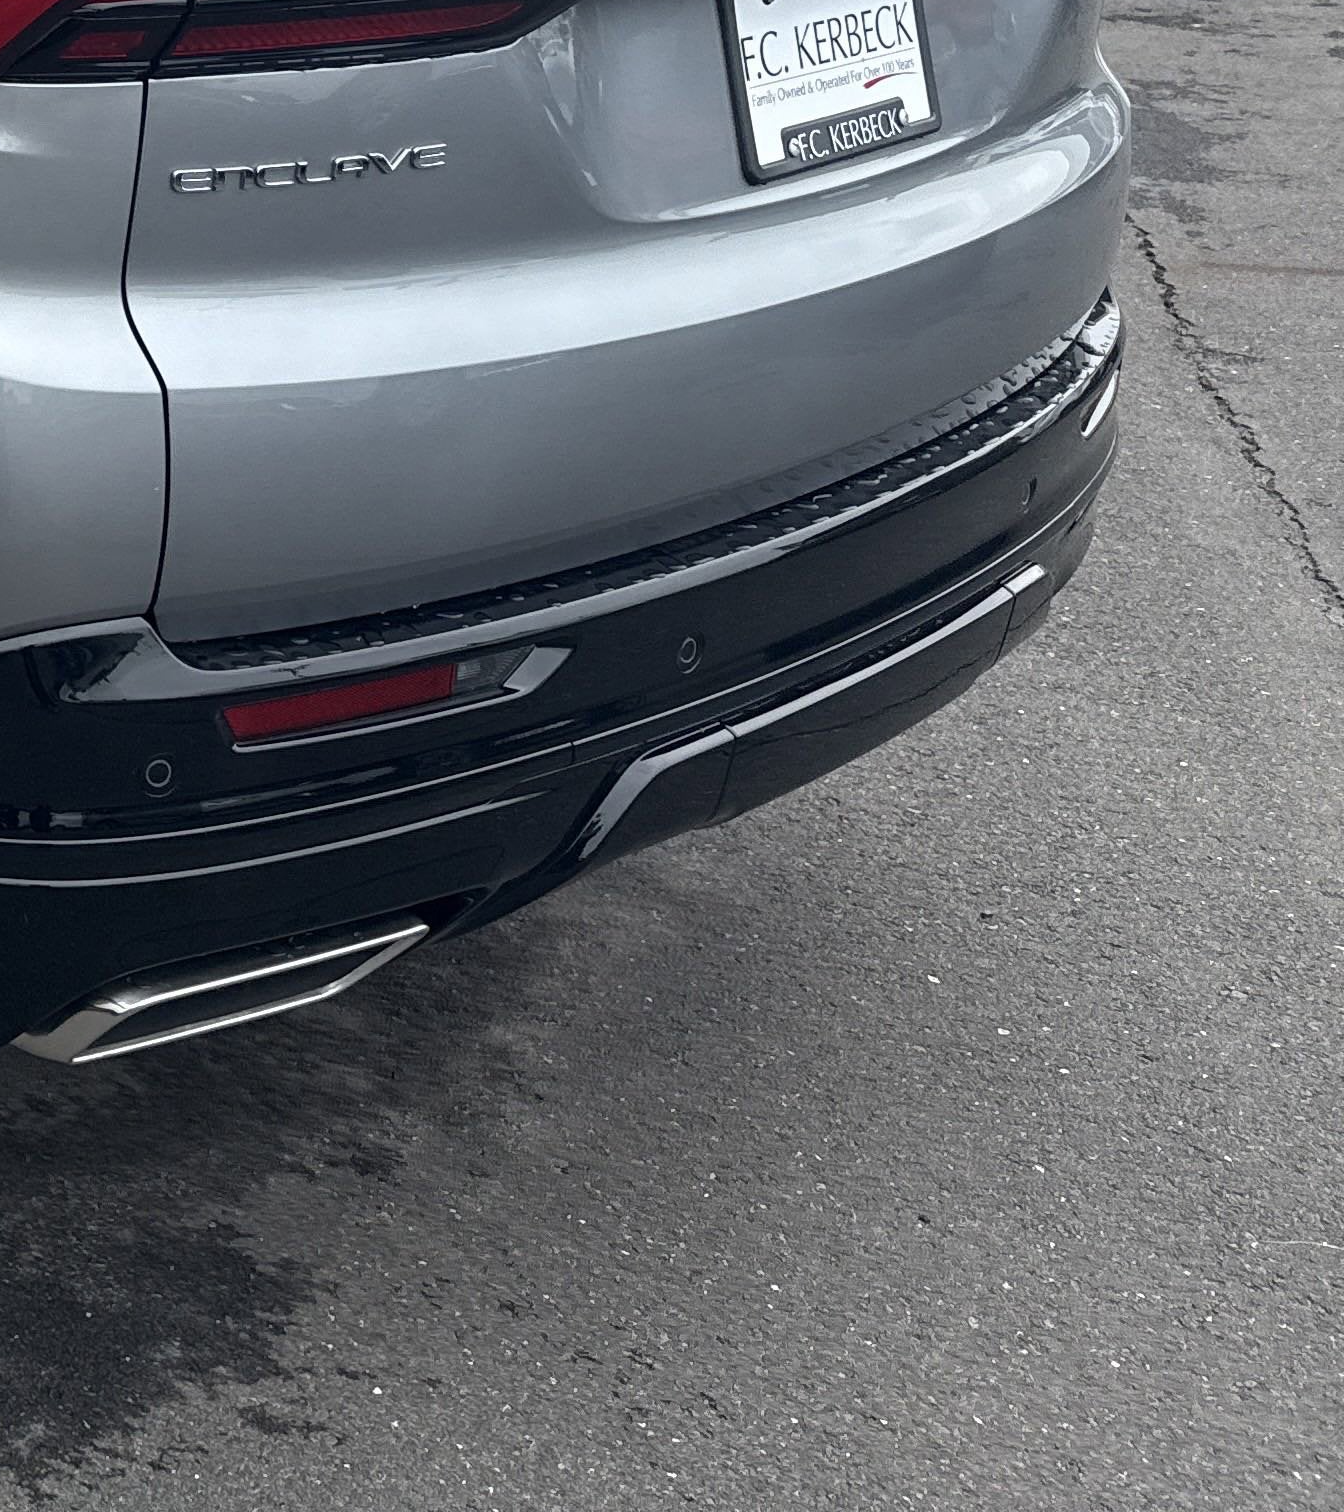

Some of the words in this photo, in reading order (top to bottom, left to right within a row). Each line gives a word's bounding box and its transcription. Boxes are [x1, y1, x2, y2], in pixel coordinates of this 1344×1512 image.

[741, 30, 789, 81] F.C.
[794, 2, 913, 69] KERBECK
[752, 91, 775, 107] Family
[777, 82, 806, 101] Owned
[808, 80, 814, 94] &
[815, 71, 850, 93] Operated
[850, 68, 863, 83] For
[864, 64, 881, 79] Over
[881, 60, 895, 74] 100
[895, 57, 915, 72] Years
[797, 129, 829, 161] F.C.
[828, 107, 902, 153] KERBECK
[170, 143, 448, 192] ENCLAVE
